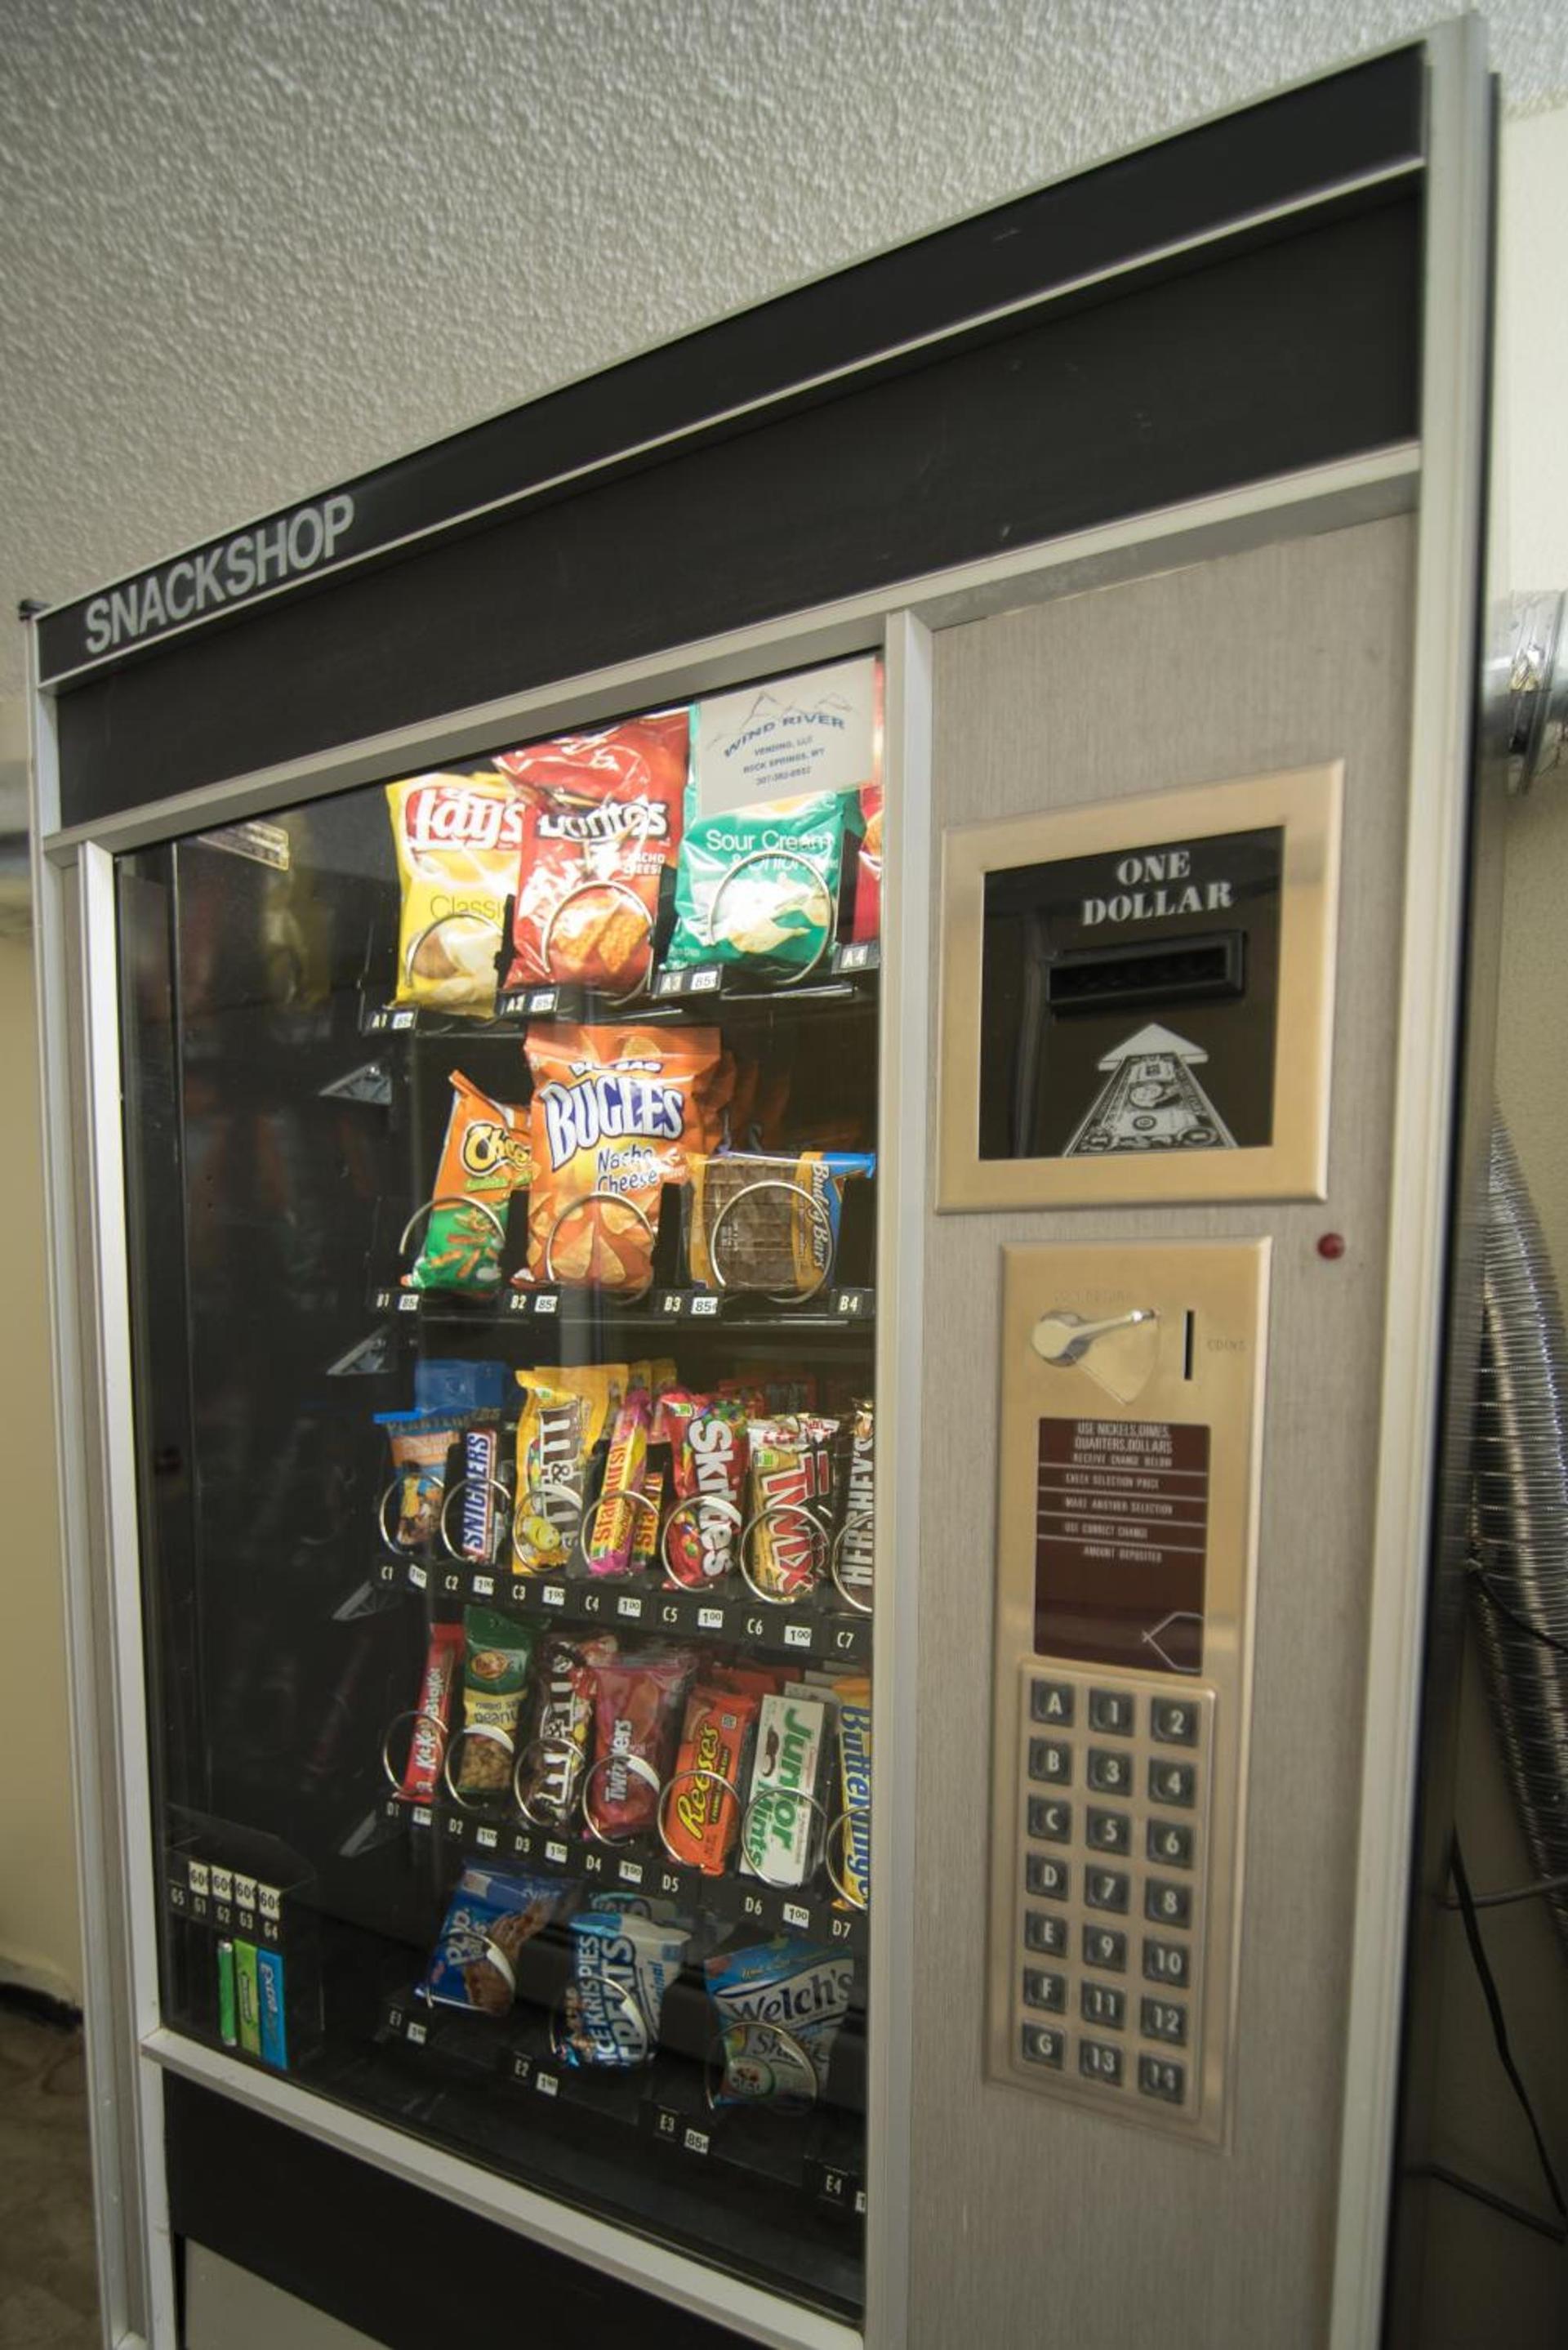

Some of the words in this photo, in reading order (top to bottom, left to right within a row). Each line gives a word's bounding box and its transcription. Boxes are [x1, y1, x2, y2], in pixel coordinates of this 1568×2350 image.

[86, 494, 354, 653] SNACKSHOP
[724, 721, 776, 757] WIND
[782, 714, 845, 729] RIVER
[706, 829, 755, 851] Sour
[761, 829, 834, 851] Cream
[1116, 850, 1192, 886] ONE
[430, 894, 501, 920] Classi
[1081, 881, 1234, 926] DOLLAR
[844, 949, 865, 967] A4
[507, 994, 525, 1013] A2
[372, 1014, 387, 1028] A1
[539, 1075, 684, 1173] BUGLES
[598, 1144, 653, 1173] Nacho
[598, 1170, 657, 1193] Cheese
[813, 1225, 829, 1267] Bars
[376, 1293, 390, 1307] B1
[510, 1295, 527, 1309] B2
[664, 1295, 681, 1312] B3
[838, 1295, 858, 1312] B4
[1078, 1422, 1094, 1435] USE
[462, 1434, 489, 1548] SNICKERS
[1093, 1474, 1134, 1488] SELECTION
[1130, 1501, 1173, 1515] SELECTION
[761, 1451, 817, 1594] TWIX
[1117, 1525, 1148, 1539] CHANGE
[381, 1566, 393, 1581] C1
[445, 1576, 458, 1590] C2
[513, 1585, 526, 1600] C3
[585, 1595, 599, 1612] C4
[663, 1606, 678, 1622] C5
[746, 1618, 764, 1635] C6
[837, 1631, 854, 1650] C7
[1047, 1692, 1062, 1715] A
[1110, 1700, 1118, 1724] 1
[1169, 1710, 1184, 1735] 2
[415, 1719, 438, 1770] KitKa
[605, 1719, 632, 1802] Twizlers
[1048, 1749, 1060, 1772] B
[1106, 1760, 1120, 1783] 3
[677, 1721, 719, 1841] Reese's
[772, 1708, 814, 1850] Junior
[1168, 1772, 1182, 1794] 4
[386, 1801, 399, 1817] D1
[841, 1706, 871, 1899] Butterfing
[450, 1818, 463, 1835] D2
[750, 1781, 773, 1866] Mints
[1046, 1808, 1058, 1831] C
[1105, 1819, 1117, 1842] 5
[515, 1835, 530, 1853] D3
[1165, 1831, 1179, 1854] 6
[586, 1854, 601, 1872] D4
[662, 1875, 679, 1893] D5
[1043, 1864, 1058, 1887] D
[1103, 1877, 1116, 1900] 7
[745, 1897, 763, 1915] D6
[1163, 1891, 1178, 1915] 8
[832, 1920, 852, 1939] D7
[1044, 1921, 1054, 1943] E
[1102, 1936, 1113, 1959] 9
[1157, 1948, 1182, 1975] 10
[578, 1933, 608, 2027] KRISPIES
[1042, 1977, 1052, 2000] F
[725, 1969, 853, 2022] Welch's
[1094, 1990, 1116, 2017] 11
[389, 2010, 402, 2027] E1
[1154, 2006, 1179, 2033] 12
[590, 2027, 618, 2065] ICE
[1038, 2034, 1053, 2055] G
[514, 2058, 529, 2077] E2
[1091, 2047, 1115, 2074] 13
[1152, 2063, 1176, 2090] 14
[660, 2114, 675, 2133] E3
[826, 2174, 842, 2195] E4
